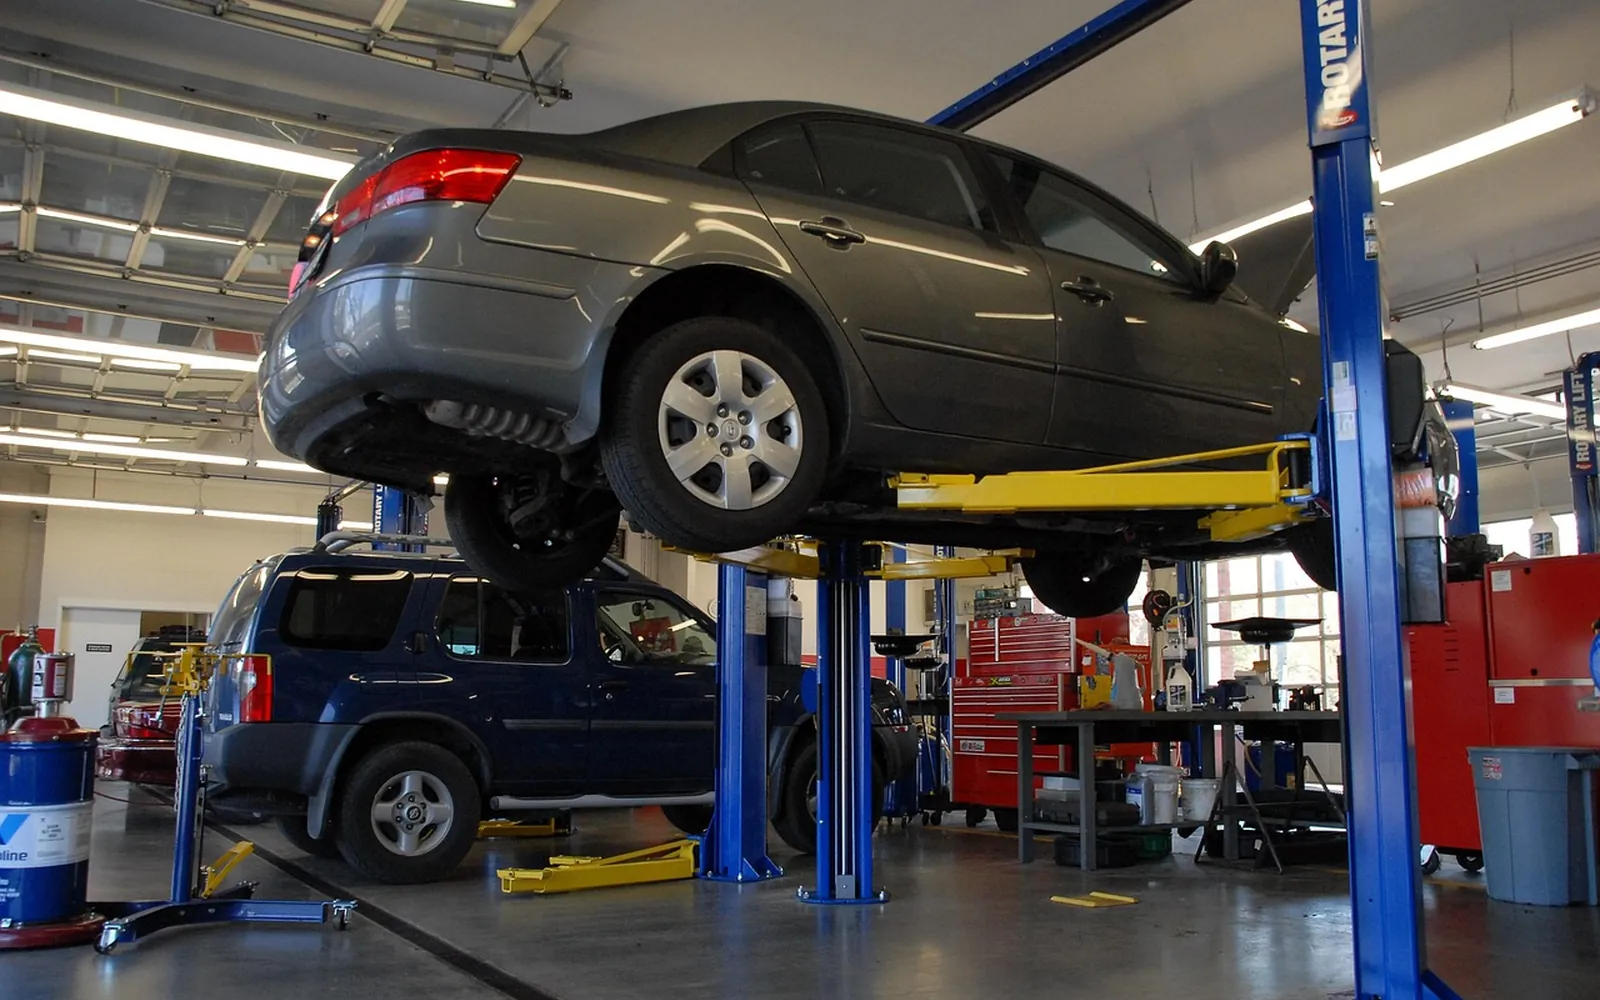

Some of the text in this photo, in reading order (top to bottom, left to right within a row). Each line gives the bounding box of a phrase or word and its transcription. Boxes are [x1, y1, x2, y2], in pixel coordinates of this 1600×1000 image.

[1316, 0, 1351, 109] ROTAR
[1571, 373, 1585, 401] LIFT
[1573, 406, 1590, 462] ROARY
[0, 850, 28, 861] line
